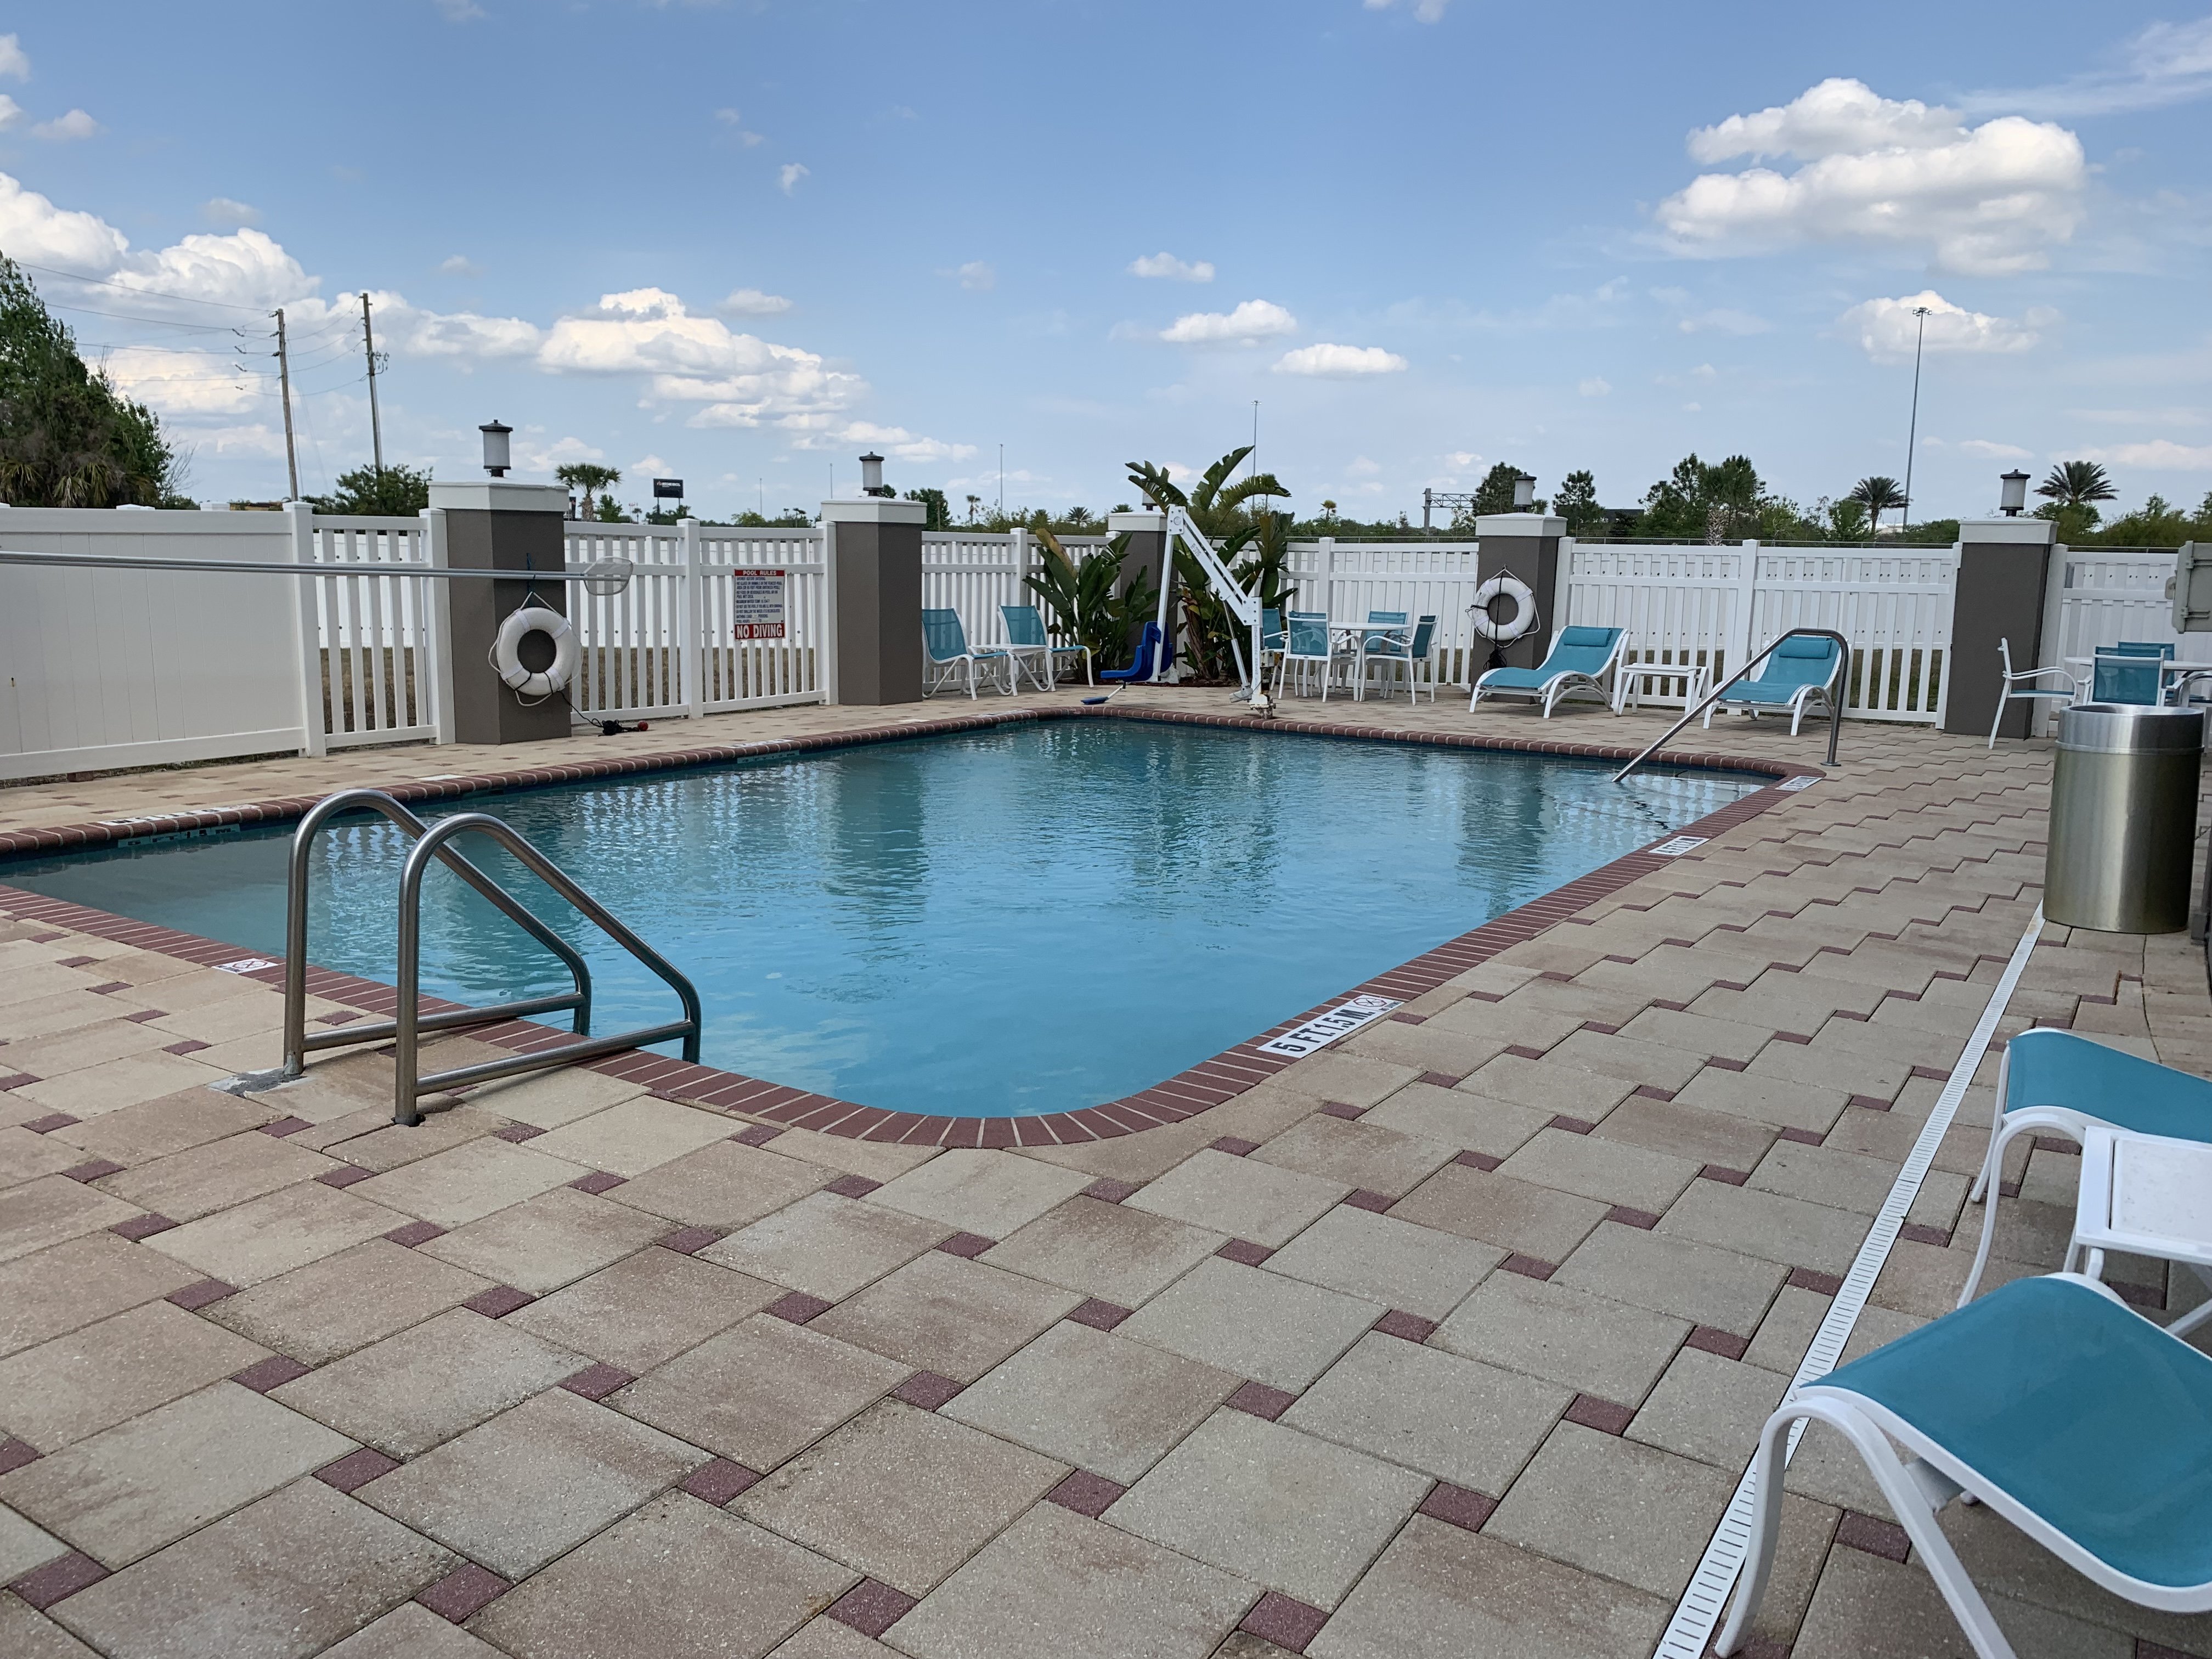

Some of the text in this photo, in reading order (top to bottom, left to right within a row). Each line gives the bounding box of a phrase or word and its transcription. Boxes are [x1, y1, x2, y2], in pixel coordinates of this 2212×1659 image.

[737, 624, 783, 639] NO DIVING
[1269, 1009, 1376, 1052] 5 FT. 1.5 M.
